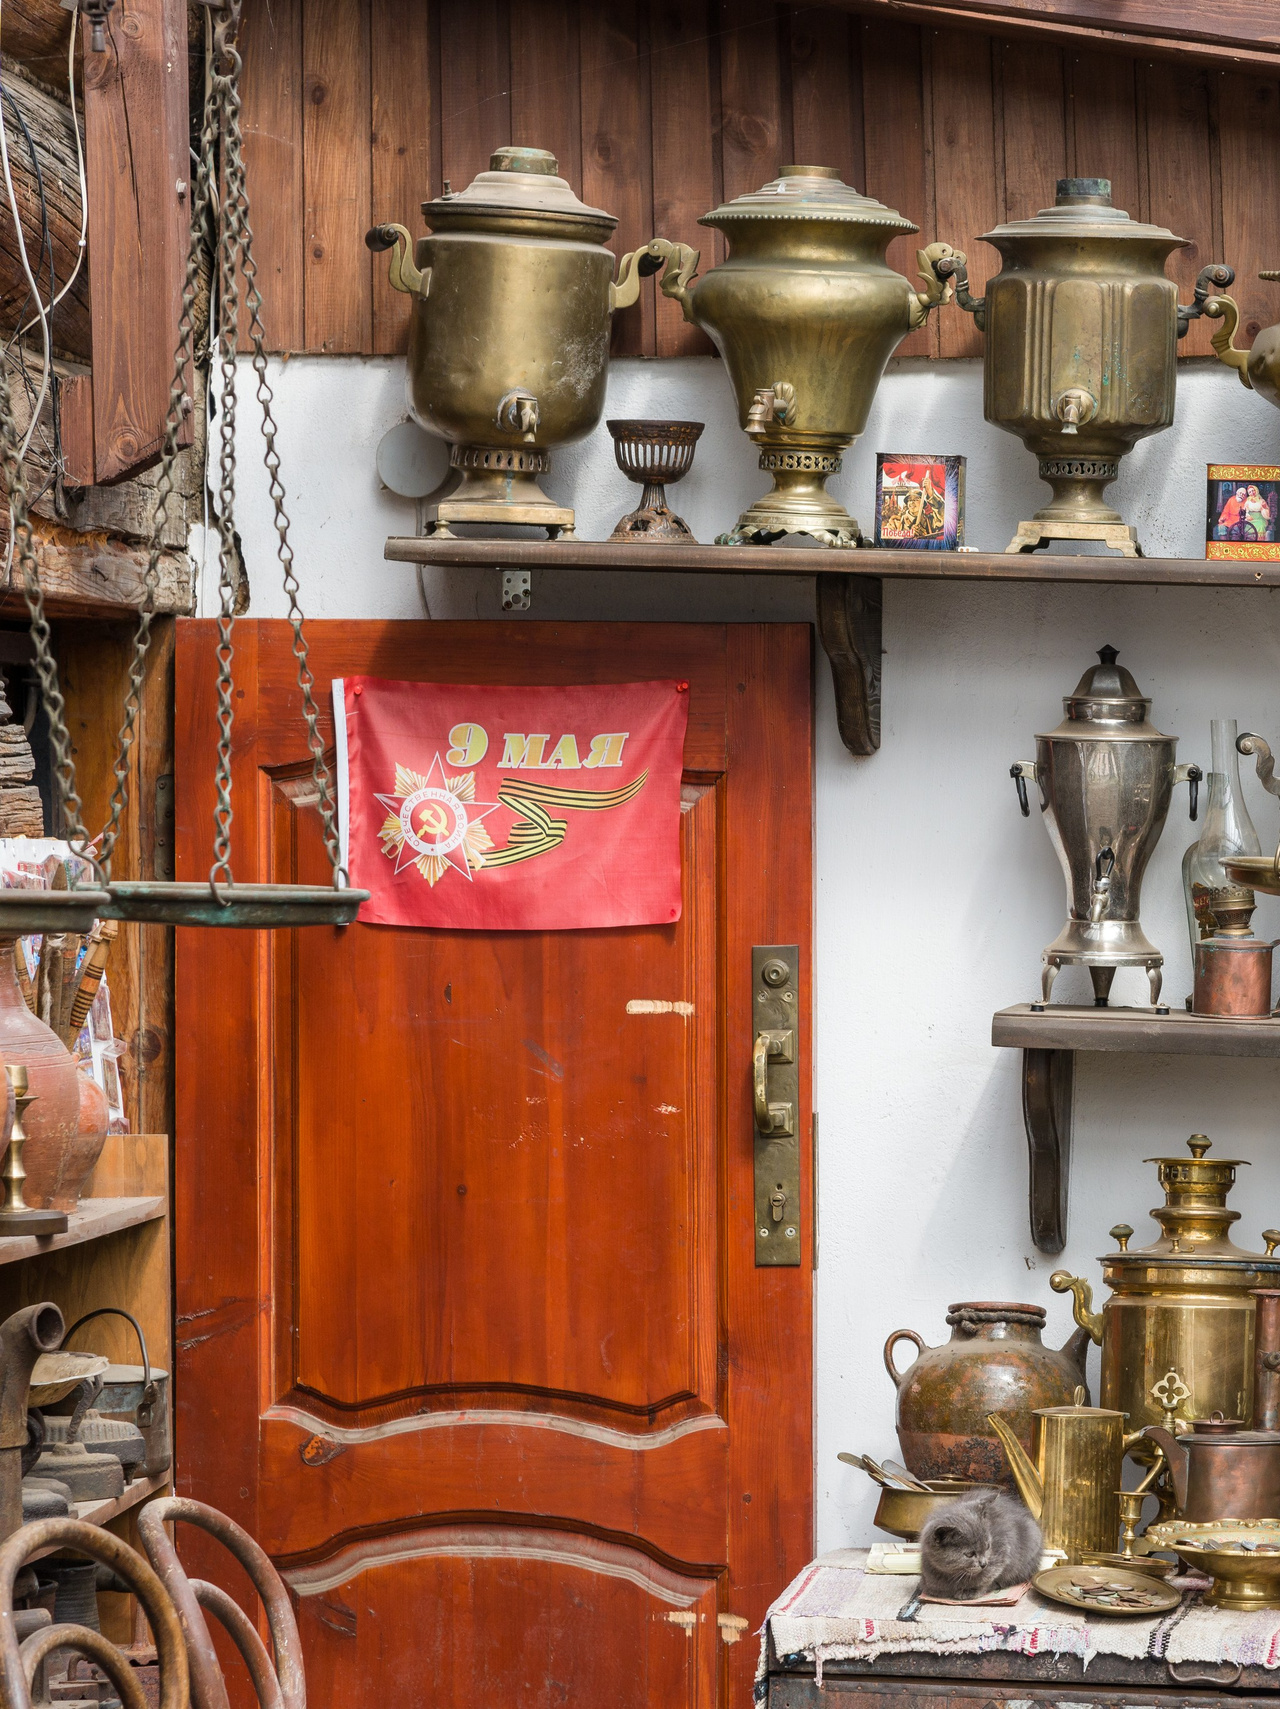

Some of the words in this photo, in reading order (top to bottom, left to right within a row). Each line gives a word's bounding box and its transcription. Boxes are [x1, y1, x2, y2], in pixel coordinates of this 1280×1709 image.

[883, 527, 914, 537] Победа!
[446, 722, 489, 768] 9
[497, 732, 629, 769] МАЯ
[402, 790, 461, 847] ОТЕЧЕСТВЕННАЯ
